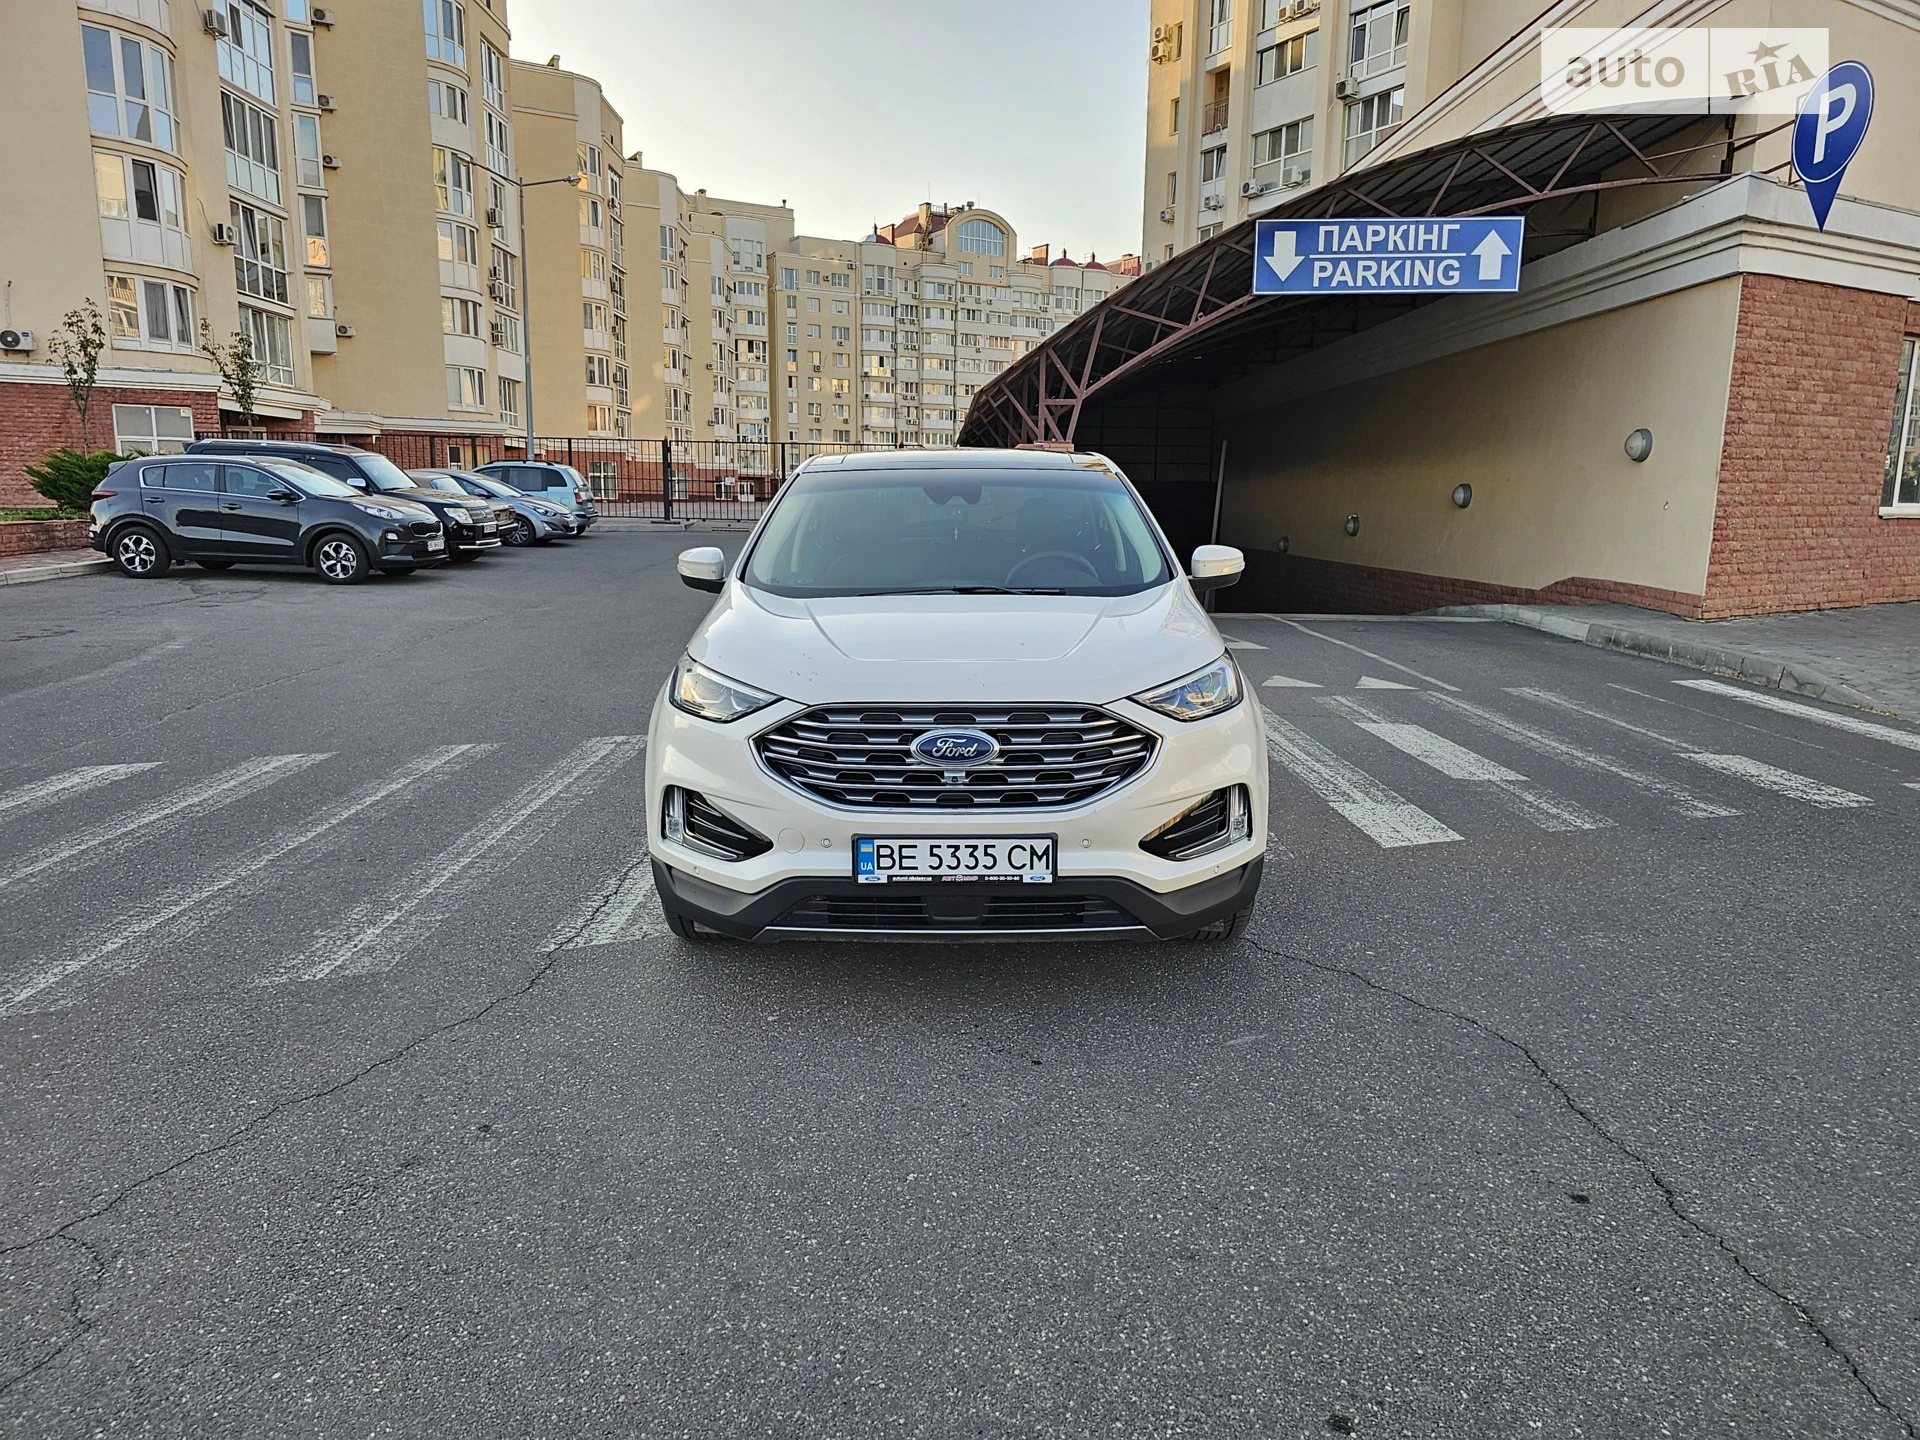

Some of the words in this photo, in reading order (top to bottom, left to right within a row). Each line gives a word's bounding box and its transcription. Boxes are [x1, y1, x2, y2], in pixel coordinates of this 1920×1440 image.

[1813, 82, 1857, 165] P
[1317, 223, 1461, 252] ПАРКІНГ
[1312, 258, 1461, 287] PARKING
[932, 737, 979, 757] Ford
[860, 862, 873, 871] UA
[876, 844, 919, 871] BE
[928, 844, 998, 871] 5335
[1007, 844, 1051, 871] CM
